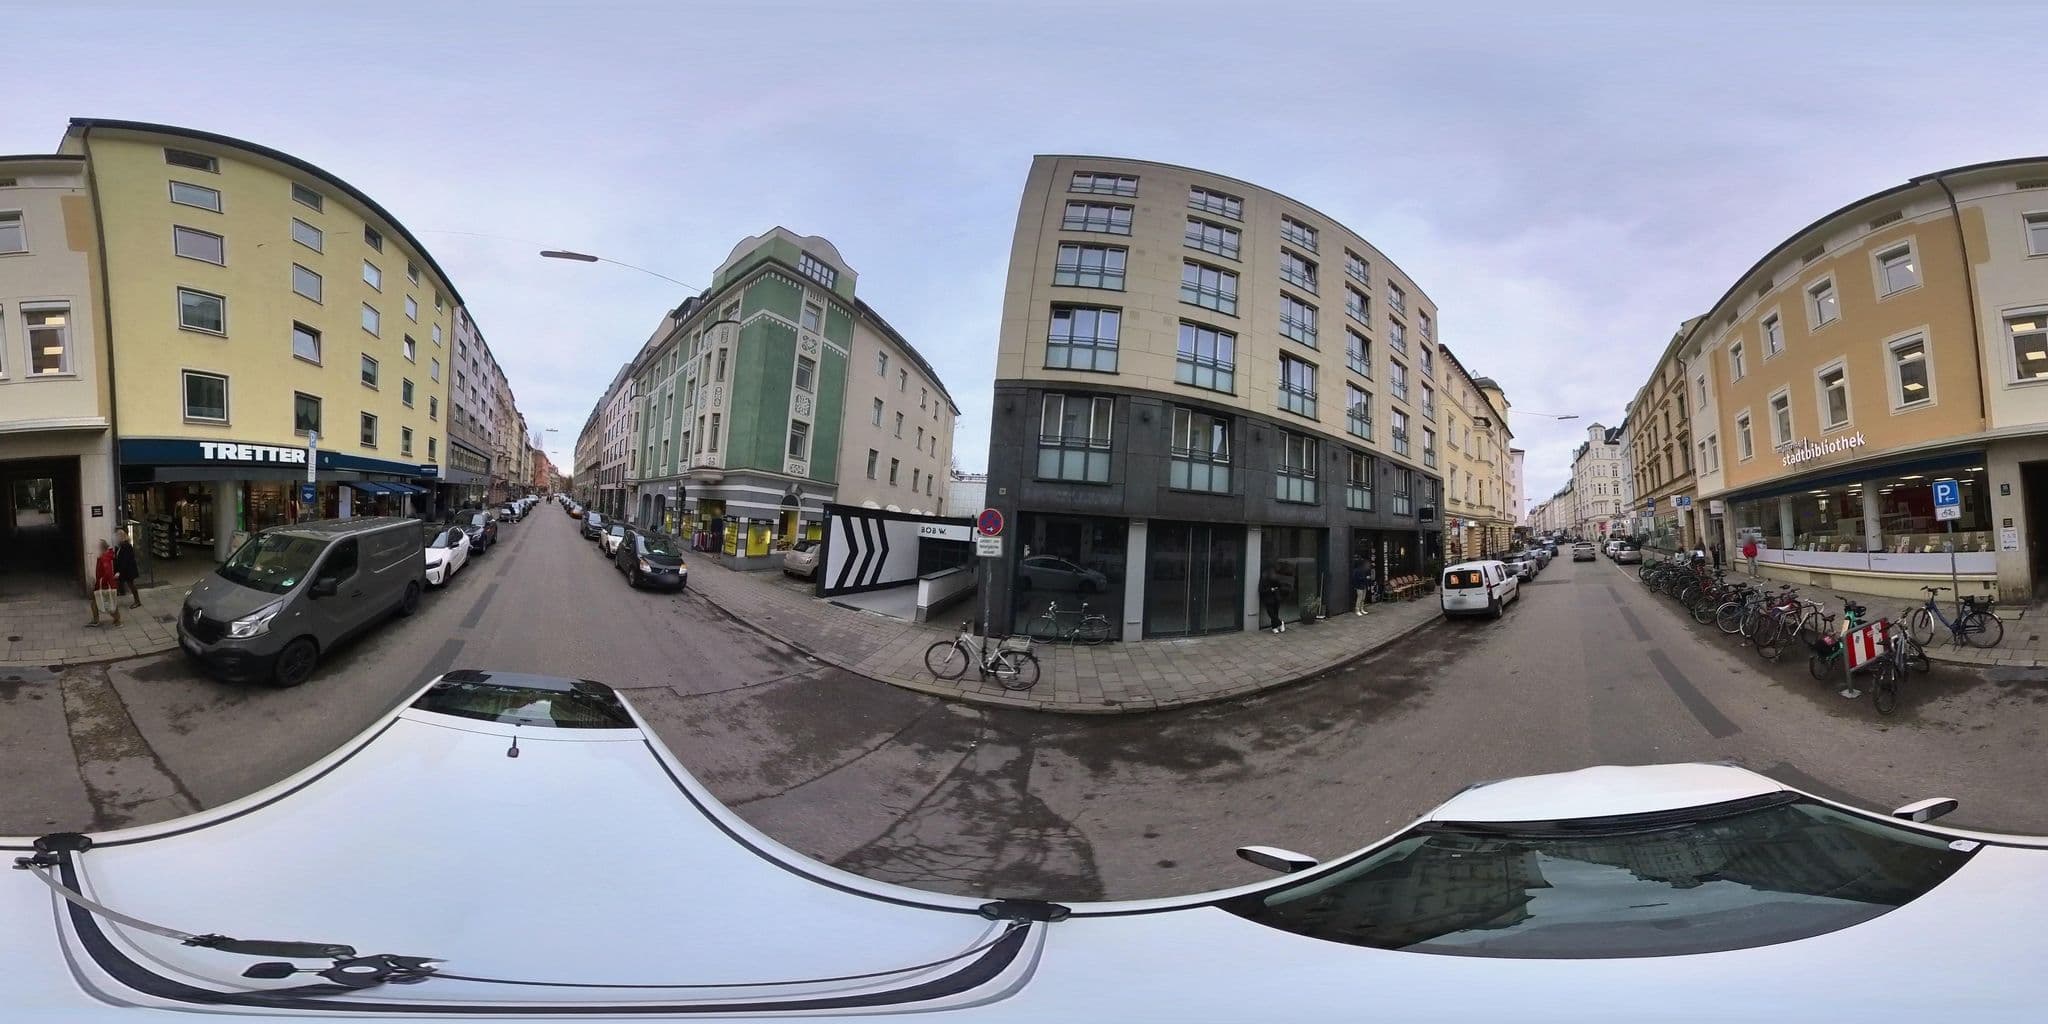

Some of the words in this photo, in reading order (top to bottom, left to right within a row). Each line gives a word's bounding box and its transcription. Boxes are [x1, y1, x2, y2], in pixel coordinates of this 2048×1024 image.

[199, 442, 306, 464] TRETTER
[1782, 431, 1866, 466] stadtbibliothek
[1937, 484, 1951, 503] P
